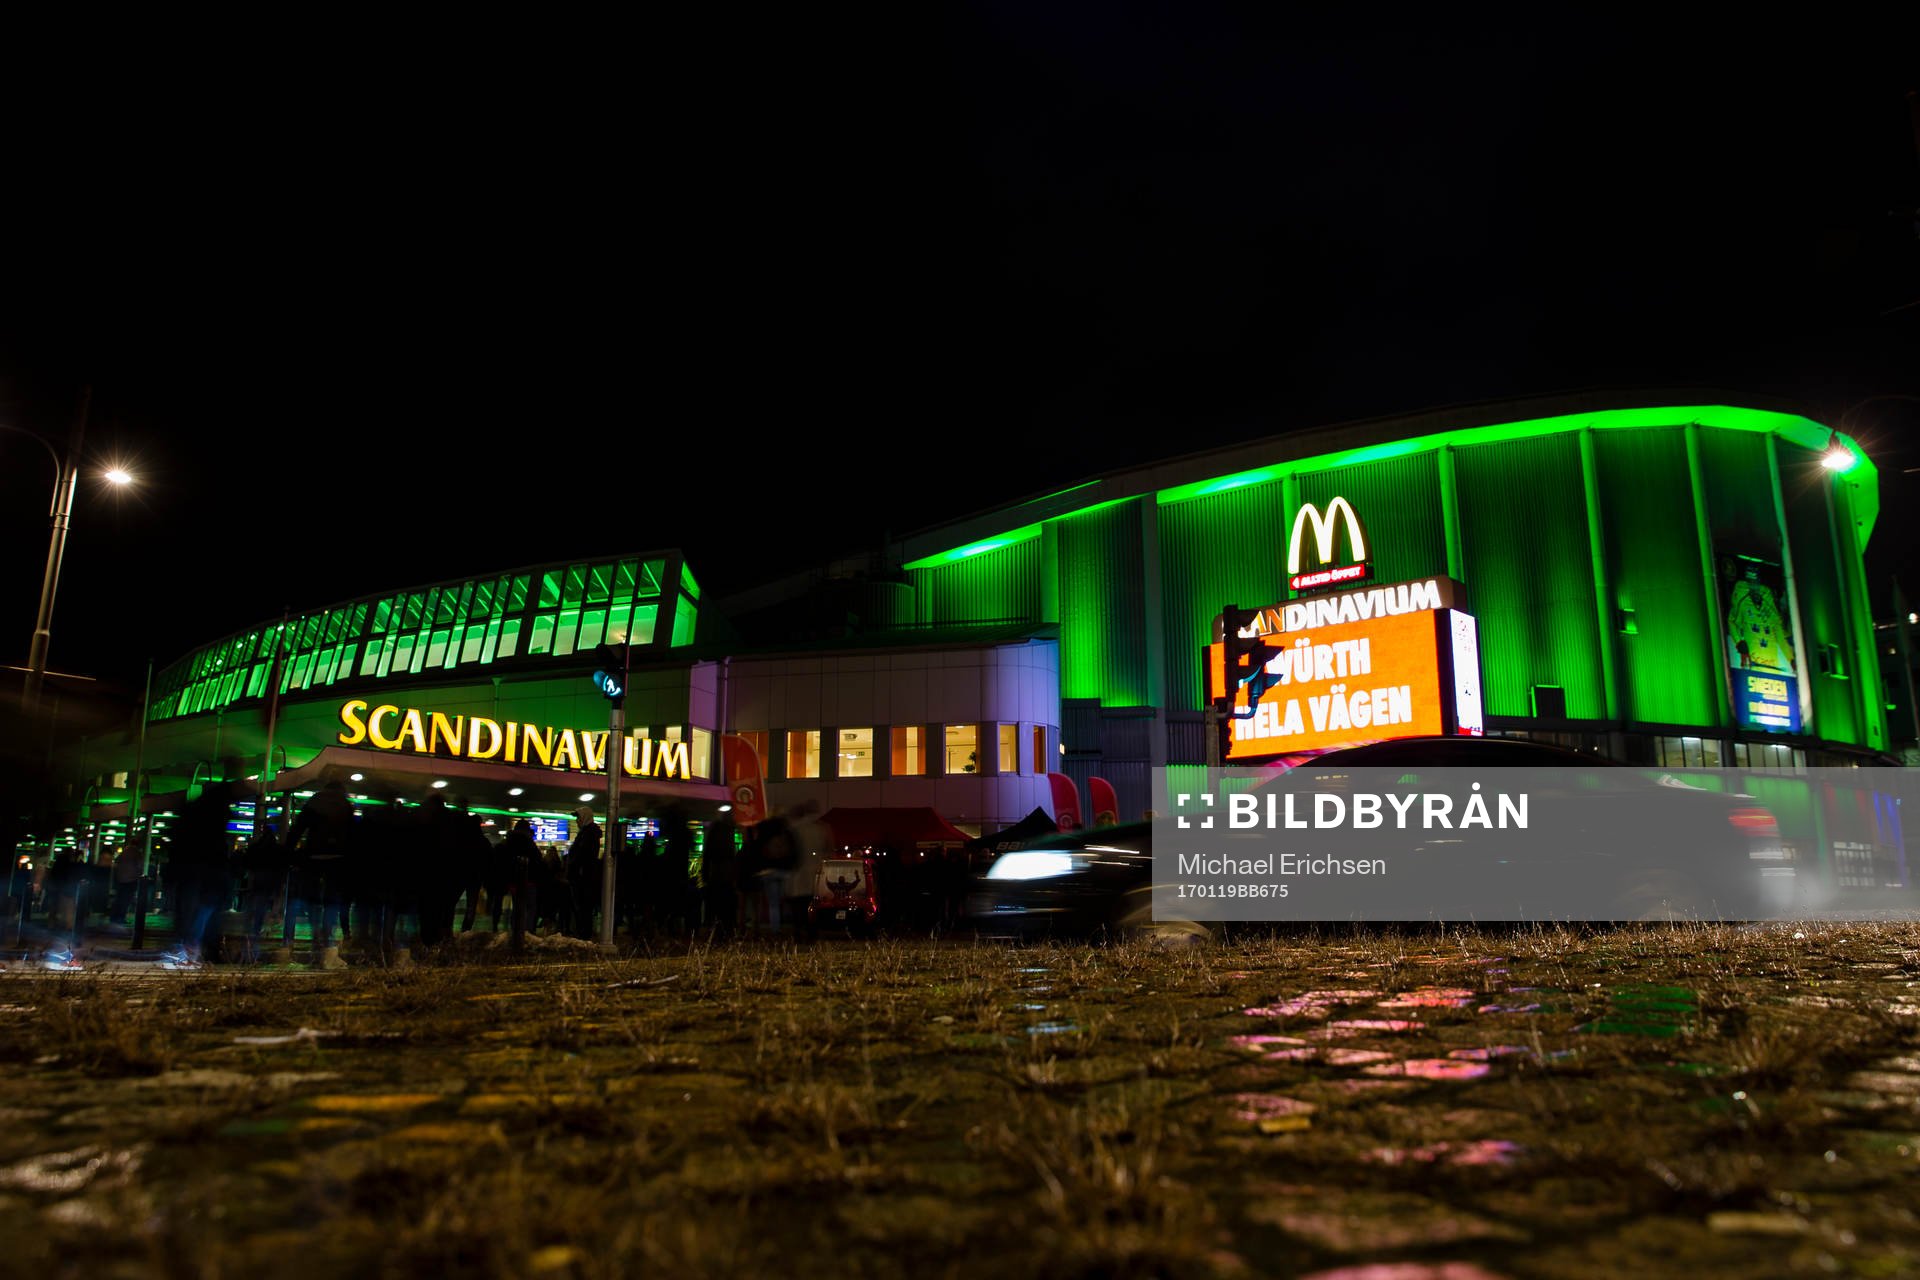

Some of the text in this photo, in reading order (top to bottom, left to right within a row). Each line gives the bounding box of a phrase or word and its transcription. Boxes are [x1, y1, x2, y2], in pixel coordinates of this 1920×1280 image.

[339, 700, 691, 780] SCANDINAVUM
[1234, 684, 1412, 741] HELA VÄGEN
